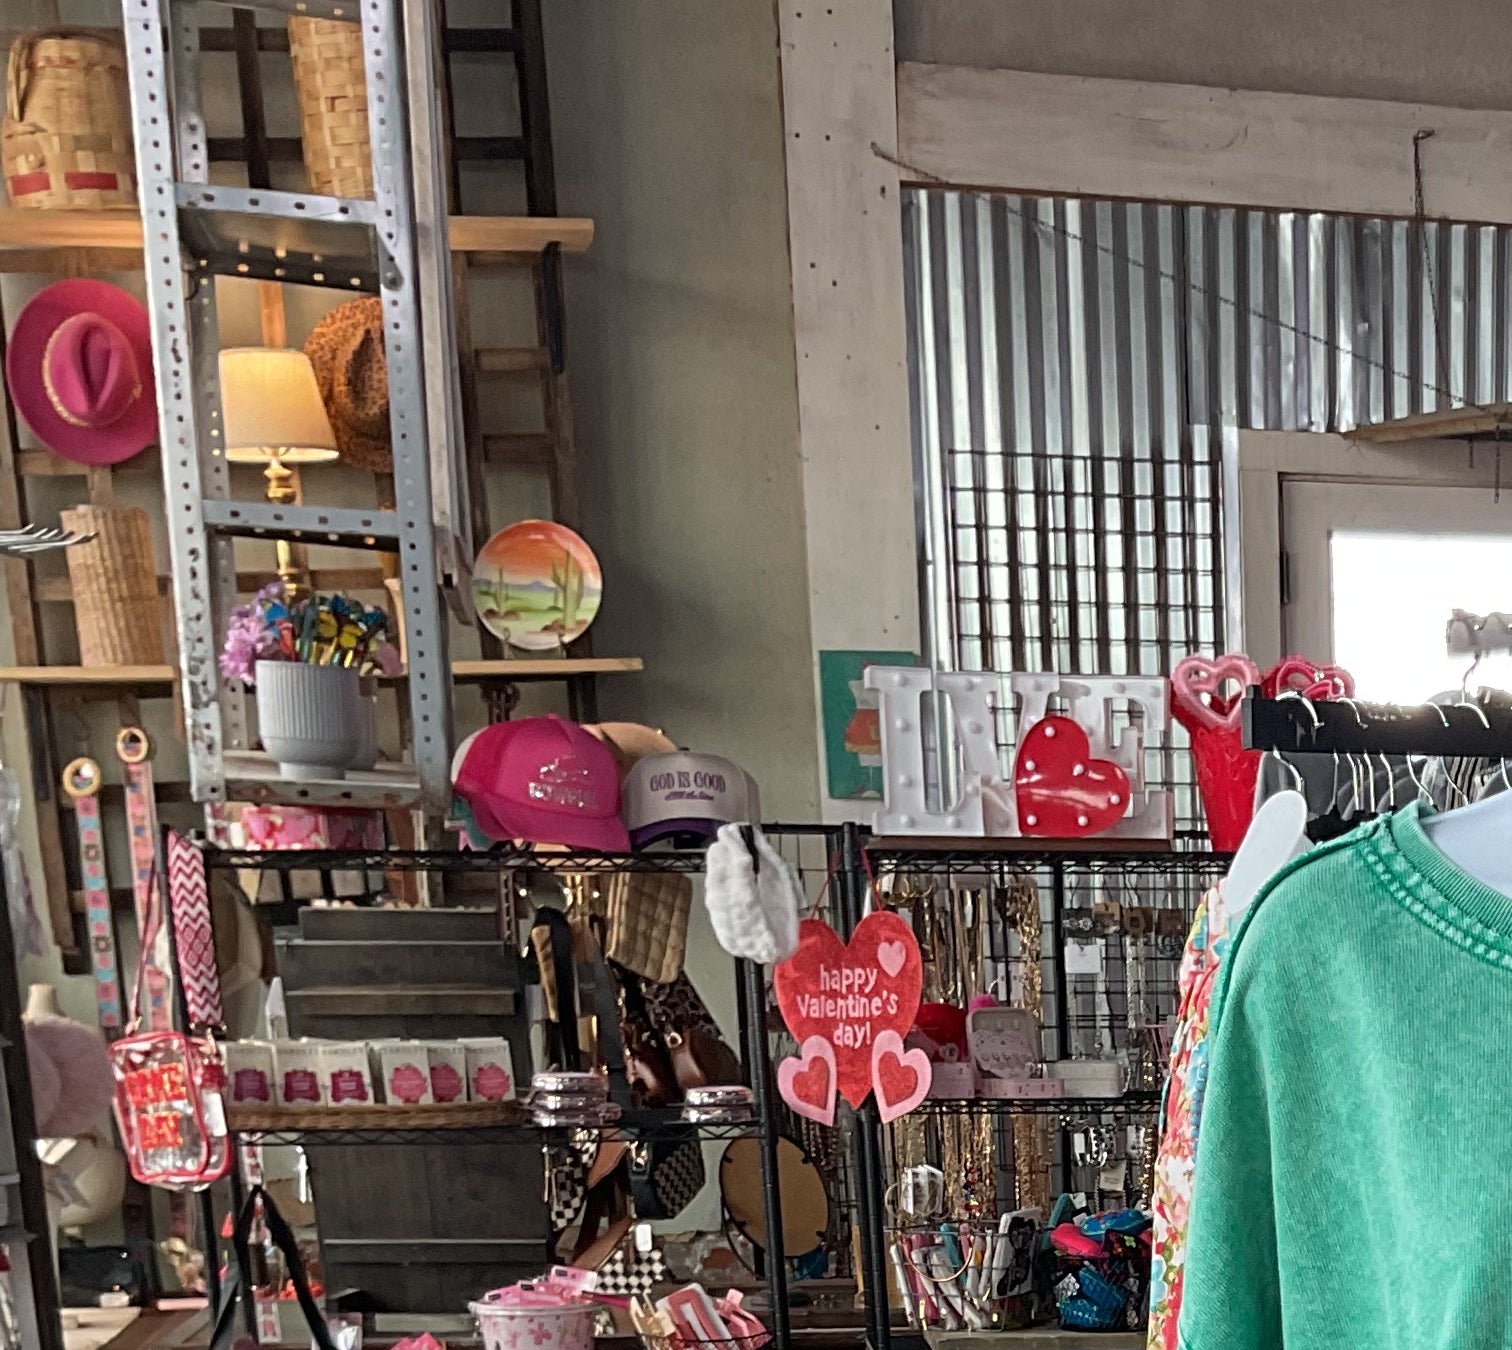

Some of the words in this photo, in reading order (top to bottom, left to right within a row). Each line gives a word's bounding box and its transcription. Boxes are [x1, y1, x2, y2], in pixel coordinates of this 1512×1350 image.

[650, 771, 676, 792] GOD
[678, 770, 690, 788] IS
[694, 771, 726, 793] GOOD
[820, 962, 878, 994] happy
[796, 989, 899, 1019] Valentine's
[833, 1021, 872, 1050] day!
